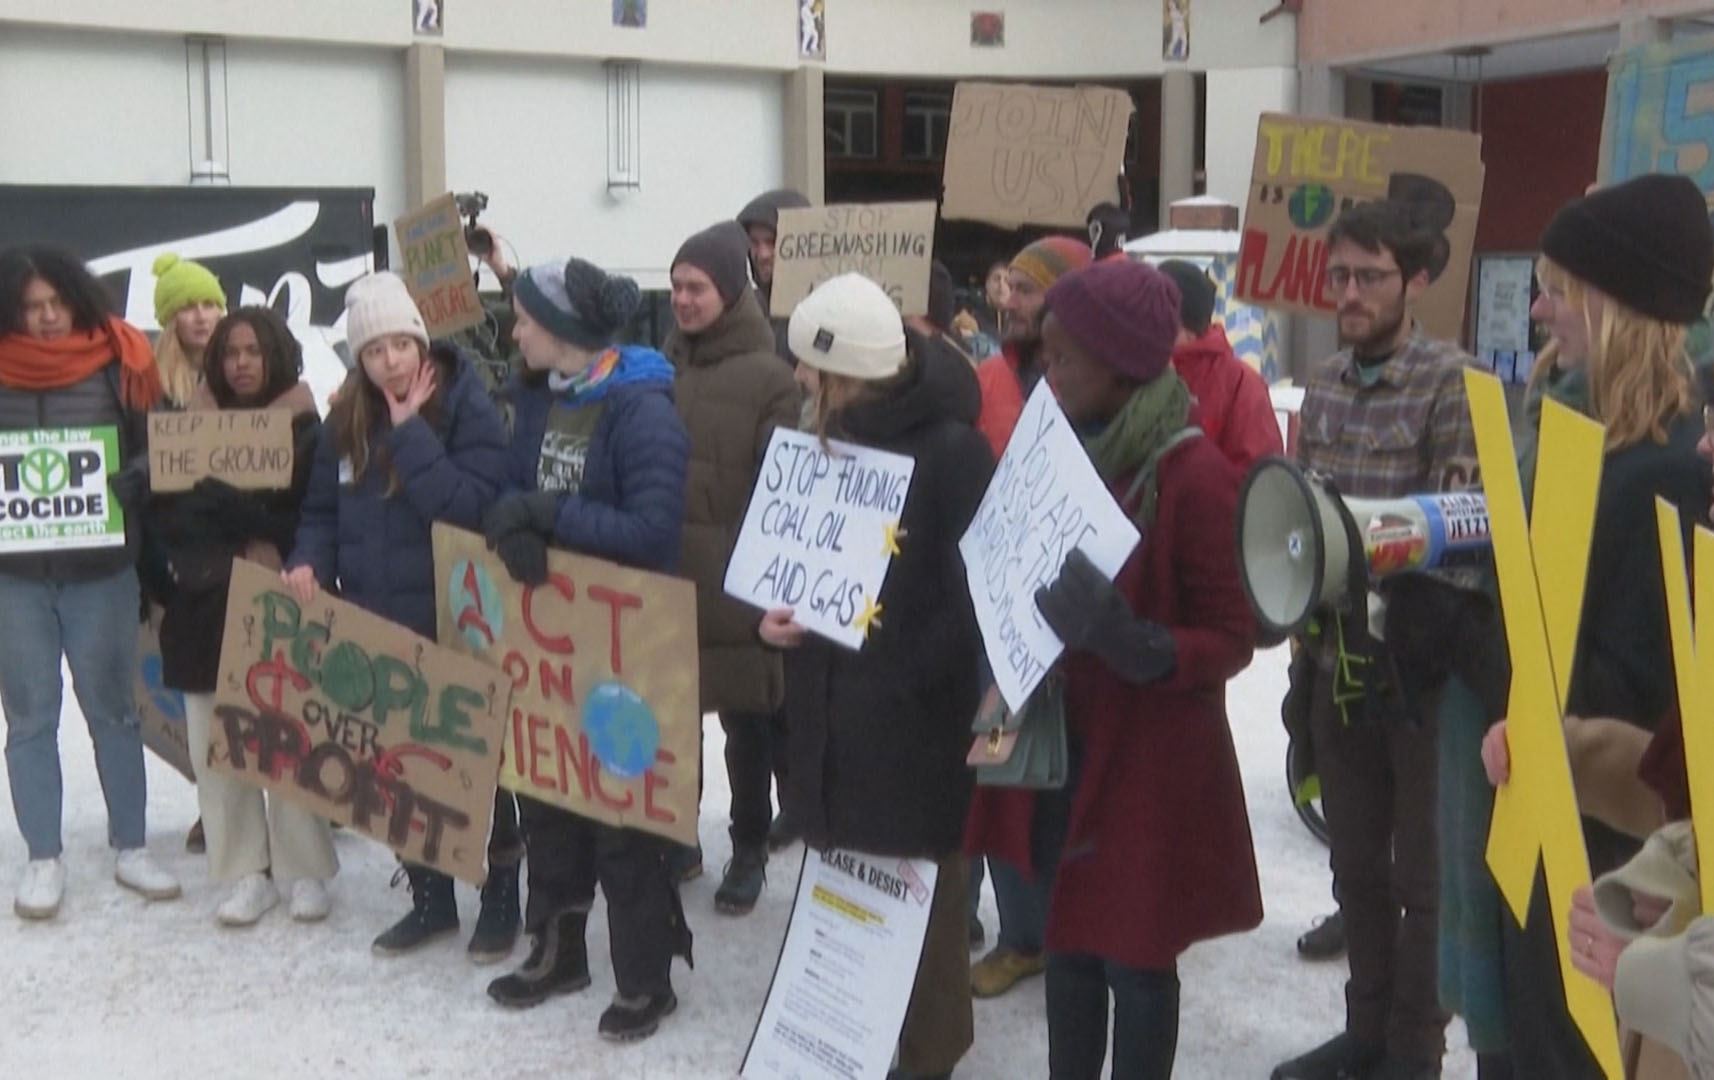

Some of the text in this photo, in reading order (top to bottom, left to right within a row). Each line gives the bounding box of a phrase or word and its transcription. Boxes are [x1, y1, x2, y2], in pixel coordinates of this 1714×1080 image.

[952, 85, 1117, 151] JOIN
[991, 149, 1105, 219] US!
[1261, 120, 1393, 188] THERE
[779, 230, 927, 261] GREENWASHING
[823, 207, 893, 231] STOP
[1234, 227, 1339, 312] PLANE
[154, 413, 270, 437] KEEP IT IN
[1021, 398, 1058, 510] YOU
[0, 447, 101, 495] TOP
[154, 443, 291, 477] THE GROUND
[765, 440, 907, 515] STOP FUNDING
[0, 494, 104, 523] OCIDE
[815, 510, 847, 552] OIL
[458, 559, 643, 675] ACT
[752, 552, 863, 628] AND GAS
[252, 590, 489, 757] PEOPLE
[501, 650, 576, 705] ON
[302, 699, 385, 757] OVER
[213, 703, 470, 863] PROFIT
[500, 707, 677, 824] IENCE
[868, 865, 910, 902] DESIST
